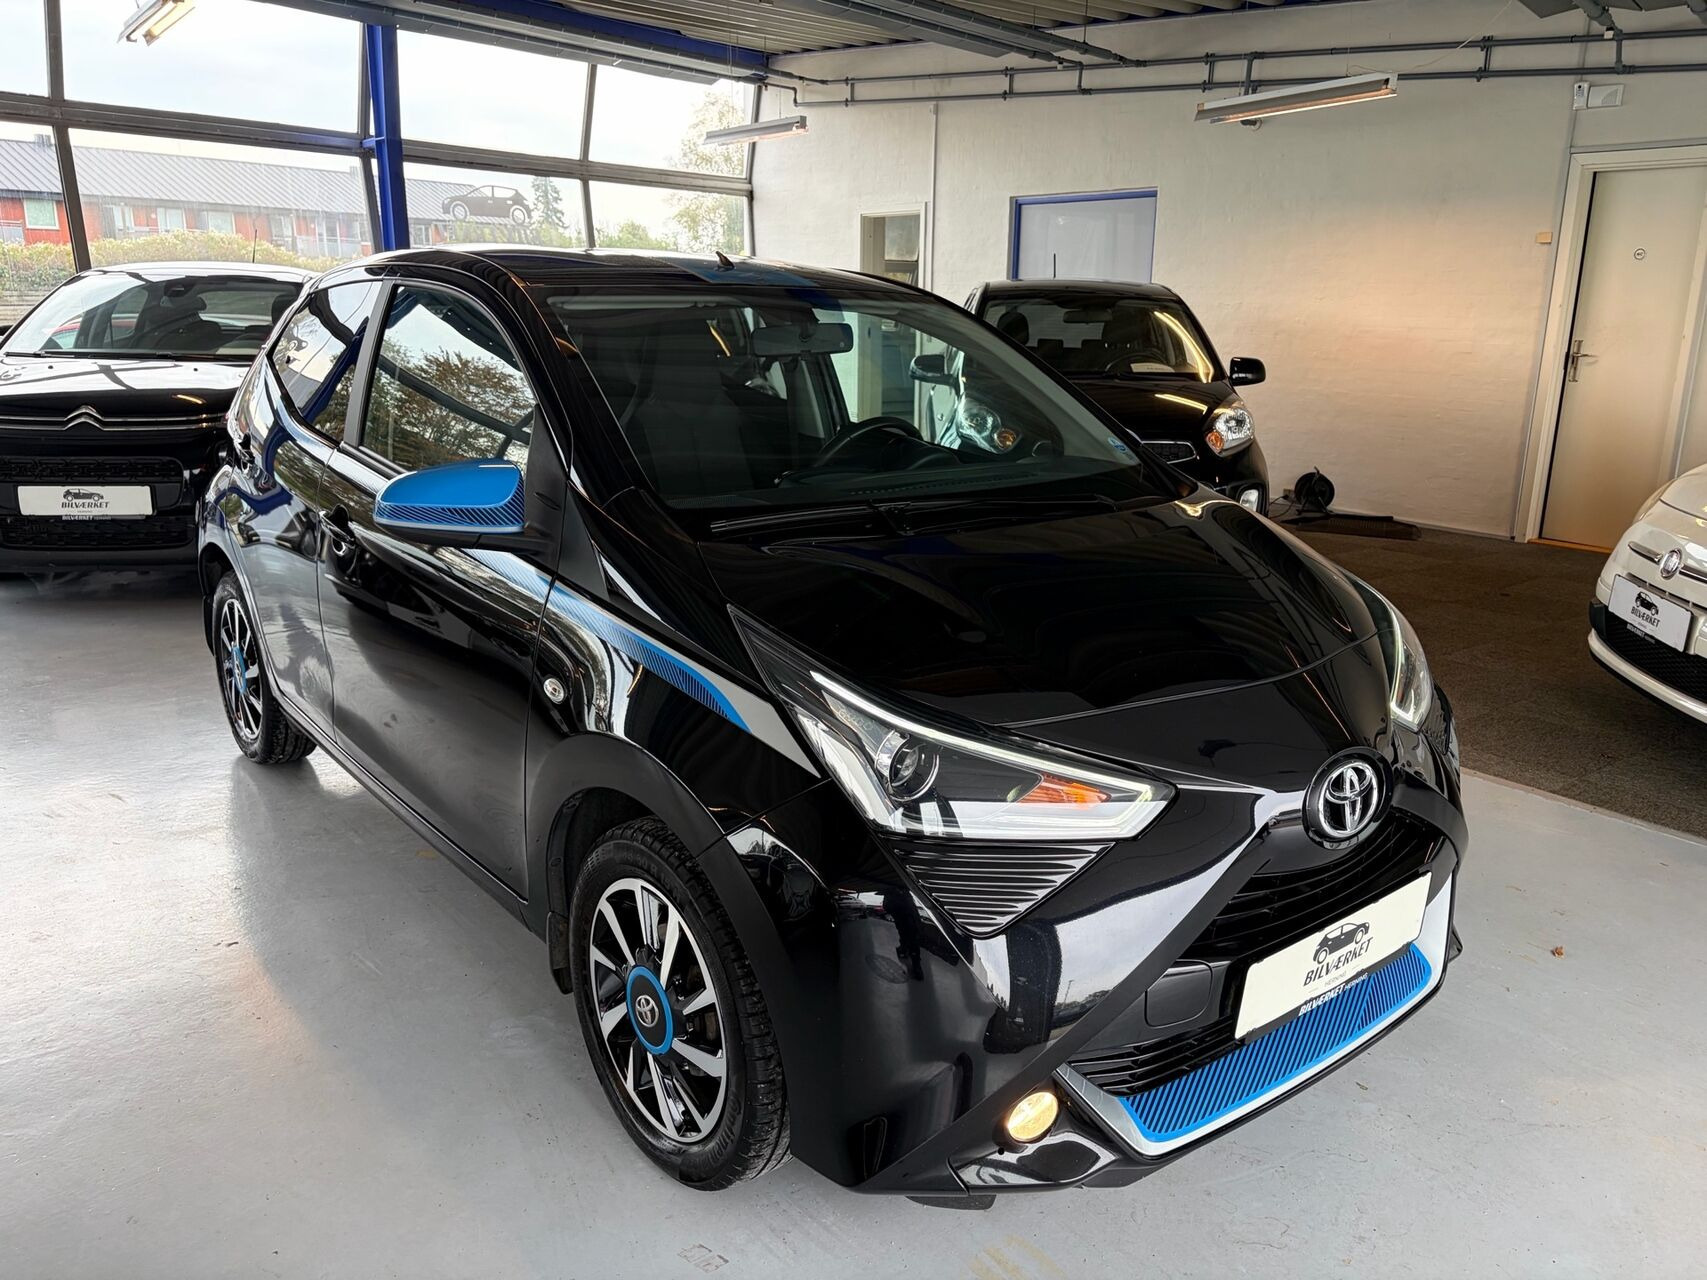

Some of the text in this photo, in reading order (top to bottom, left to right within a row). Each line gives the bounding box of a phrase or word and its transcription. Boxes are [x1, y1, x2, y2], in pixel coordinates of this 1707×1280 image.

[61, 501, 109, 509] BILVÆRKET
[1630, 606, 1660, 628] BILVÆRKET
[1303, 936, 1374, 987] BILVÆRKET
[1298, 983, 1346, 1016] BILVÆRKET
